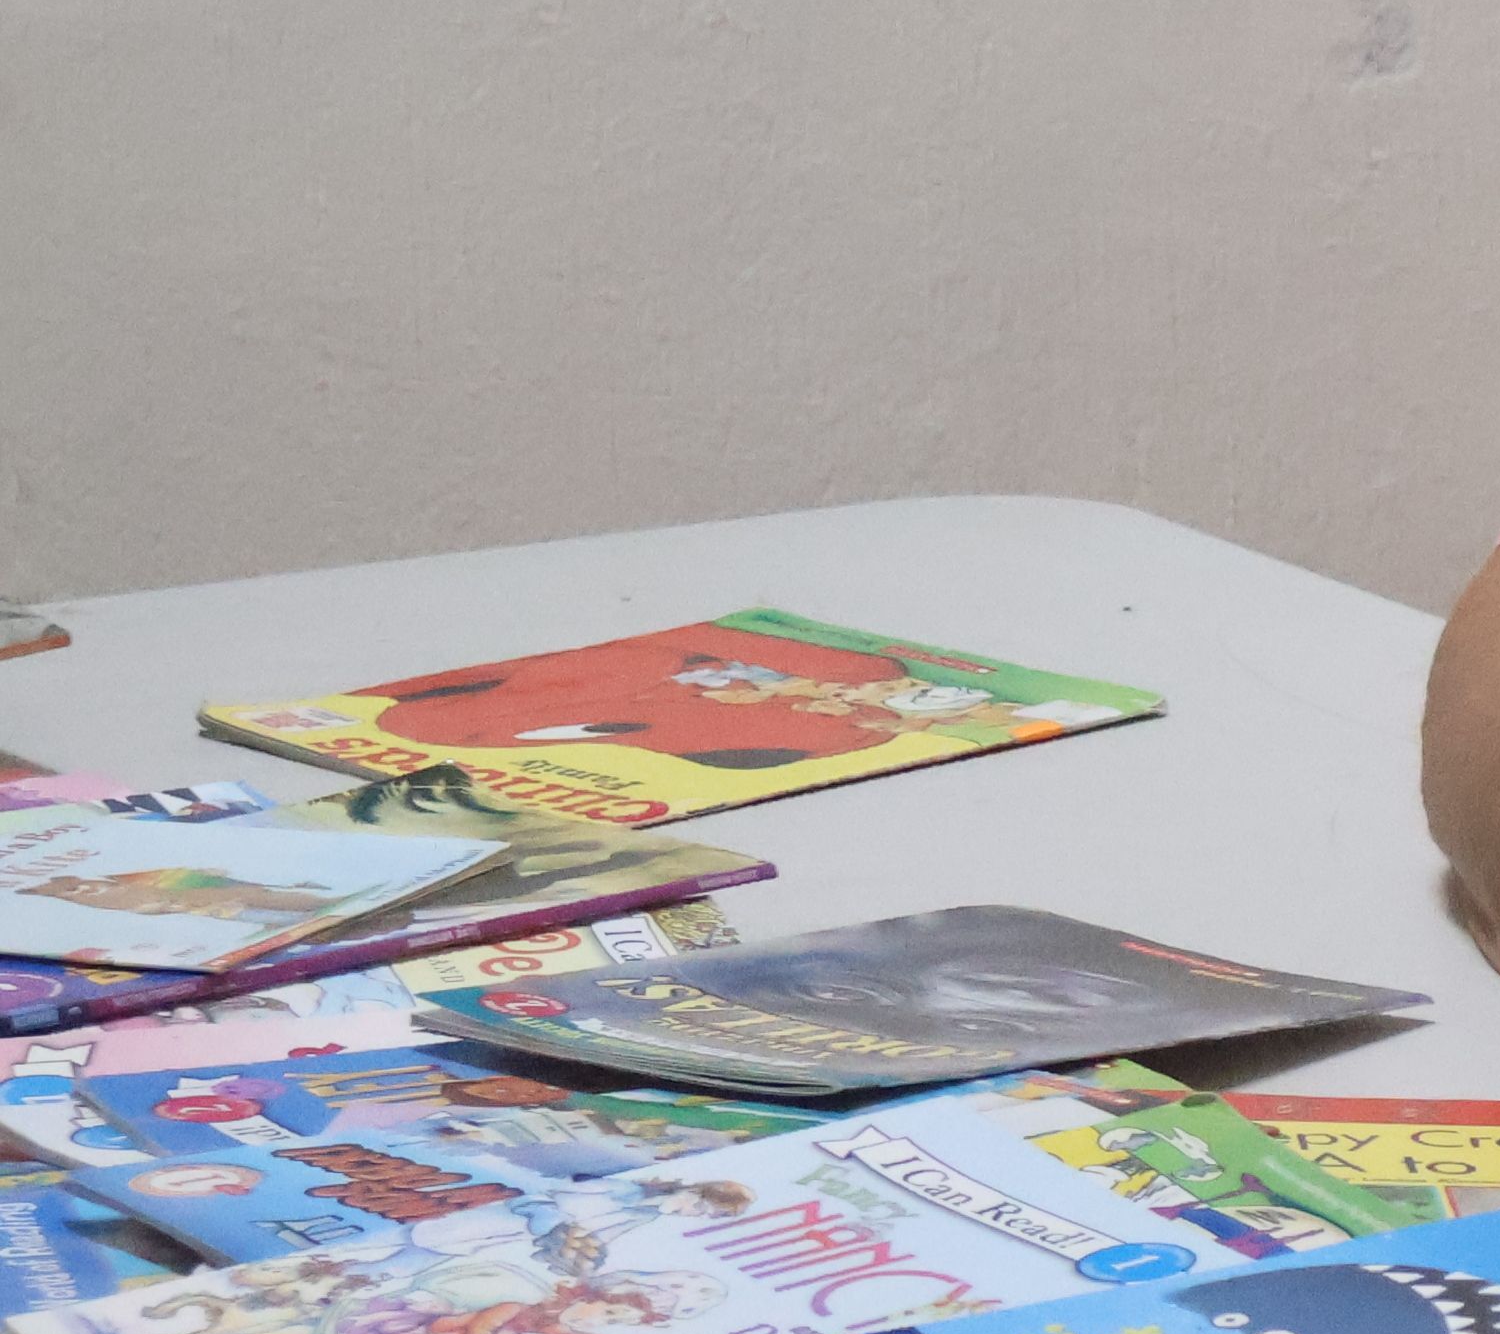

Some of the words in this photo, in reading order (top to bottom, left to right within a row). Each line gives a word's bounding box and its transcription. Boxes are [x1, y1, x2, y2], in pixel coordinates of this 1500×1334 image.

[513, 759, 645, 789] Family
[595, 975, 1016, 1060] GORILLAS!
[1283, 1130, 1376, 1158] epy
[1405, 1153, 1477, 1176] to
[794, 1163, 918, 1218] Fancy
[880, 1155, 920, 1168] I
[903, 1168, 972, 1207] Can
[976, 1194, 1094, 1249] Read!
[683, 1200, 1003, 1330] NANCY
